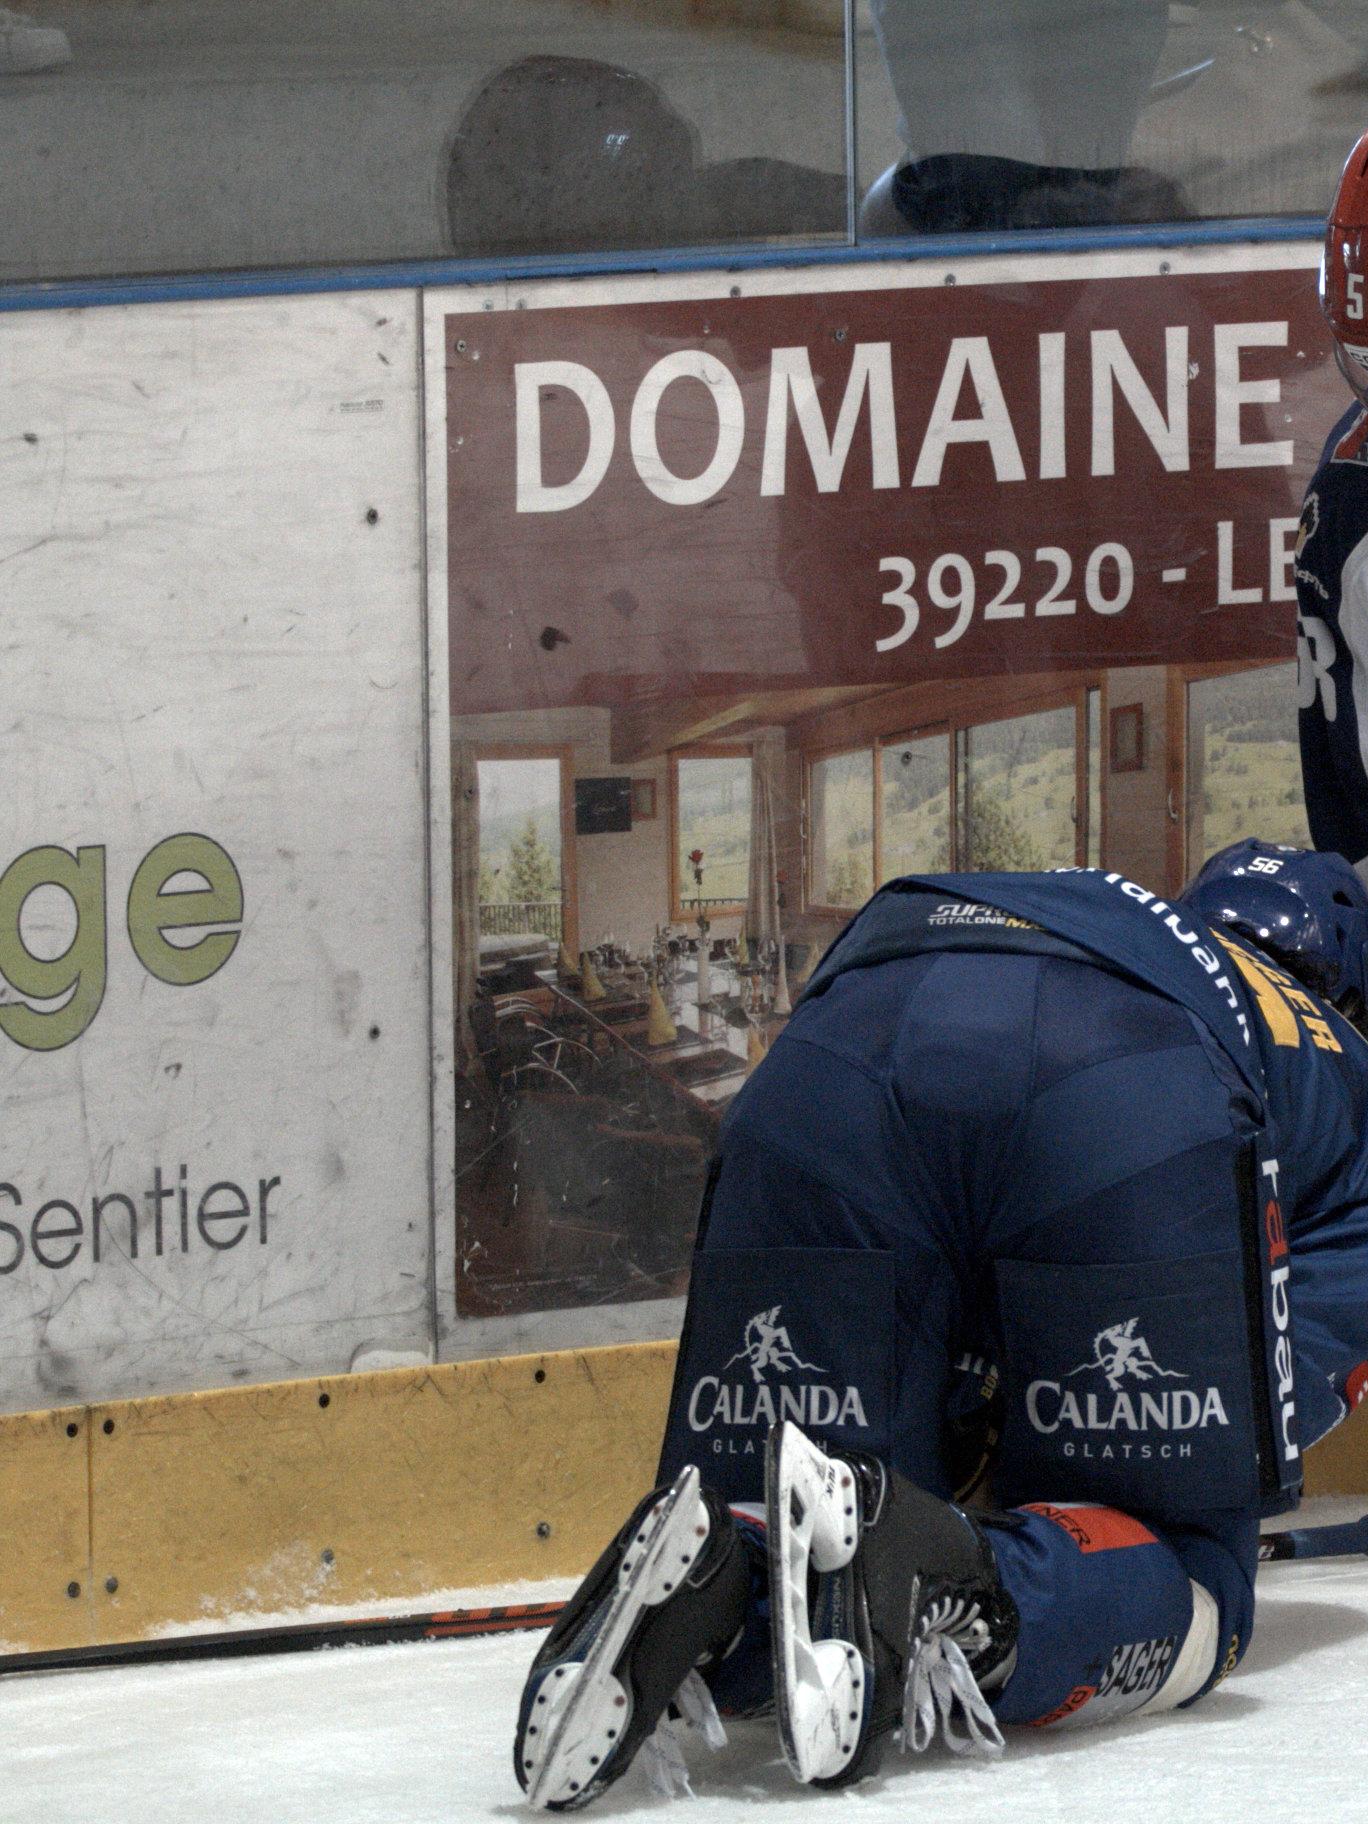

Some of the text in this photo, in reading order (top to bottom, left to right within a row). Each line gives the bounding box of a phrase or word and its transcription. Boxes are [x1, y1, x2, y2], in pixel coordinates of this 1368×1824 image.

[514, 320, 1294, 514] DOMAINE
[876, 543, 1135, 652] 39220
[1248, 856, 1284, 875] 56
[0, 832, 244, 1052] ge
[928, 916, 1006, 926] TOTALONE
[688, 1375, 869, 1433] CALANDA
[1026, 1380, 1230, 1434] CALANDA
[713, 1440, 828, 1454] GLAH
[1063, 1442, 1192, 1459] GLATSCH
